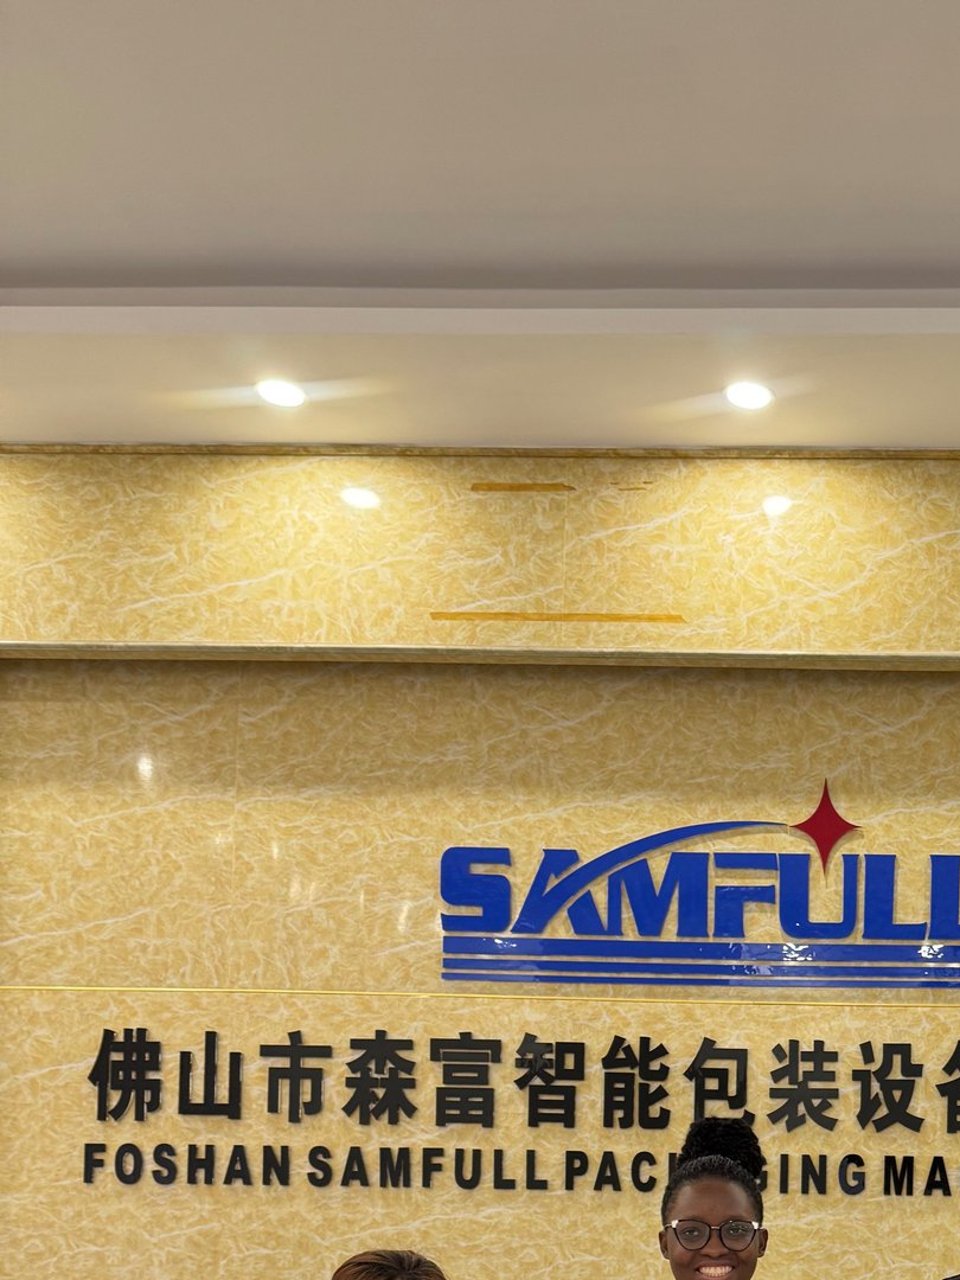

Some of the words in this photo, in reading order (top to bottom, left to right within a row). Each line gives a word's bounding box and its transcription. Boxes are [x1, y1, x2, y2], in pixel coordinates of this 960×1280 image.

[83, 1143, 290, 1187] FOSHAN
[307, 1145, 547, 1192] SAMFULL
[564, 1149, 865, 1196] PACING
